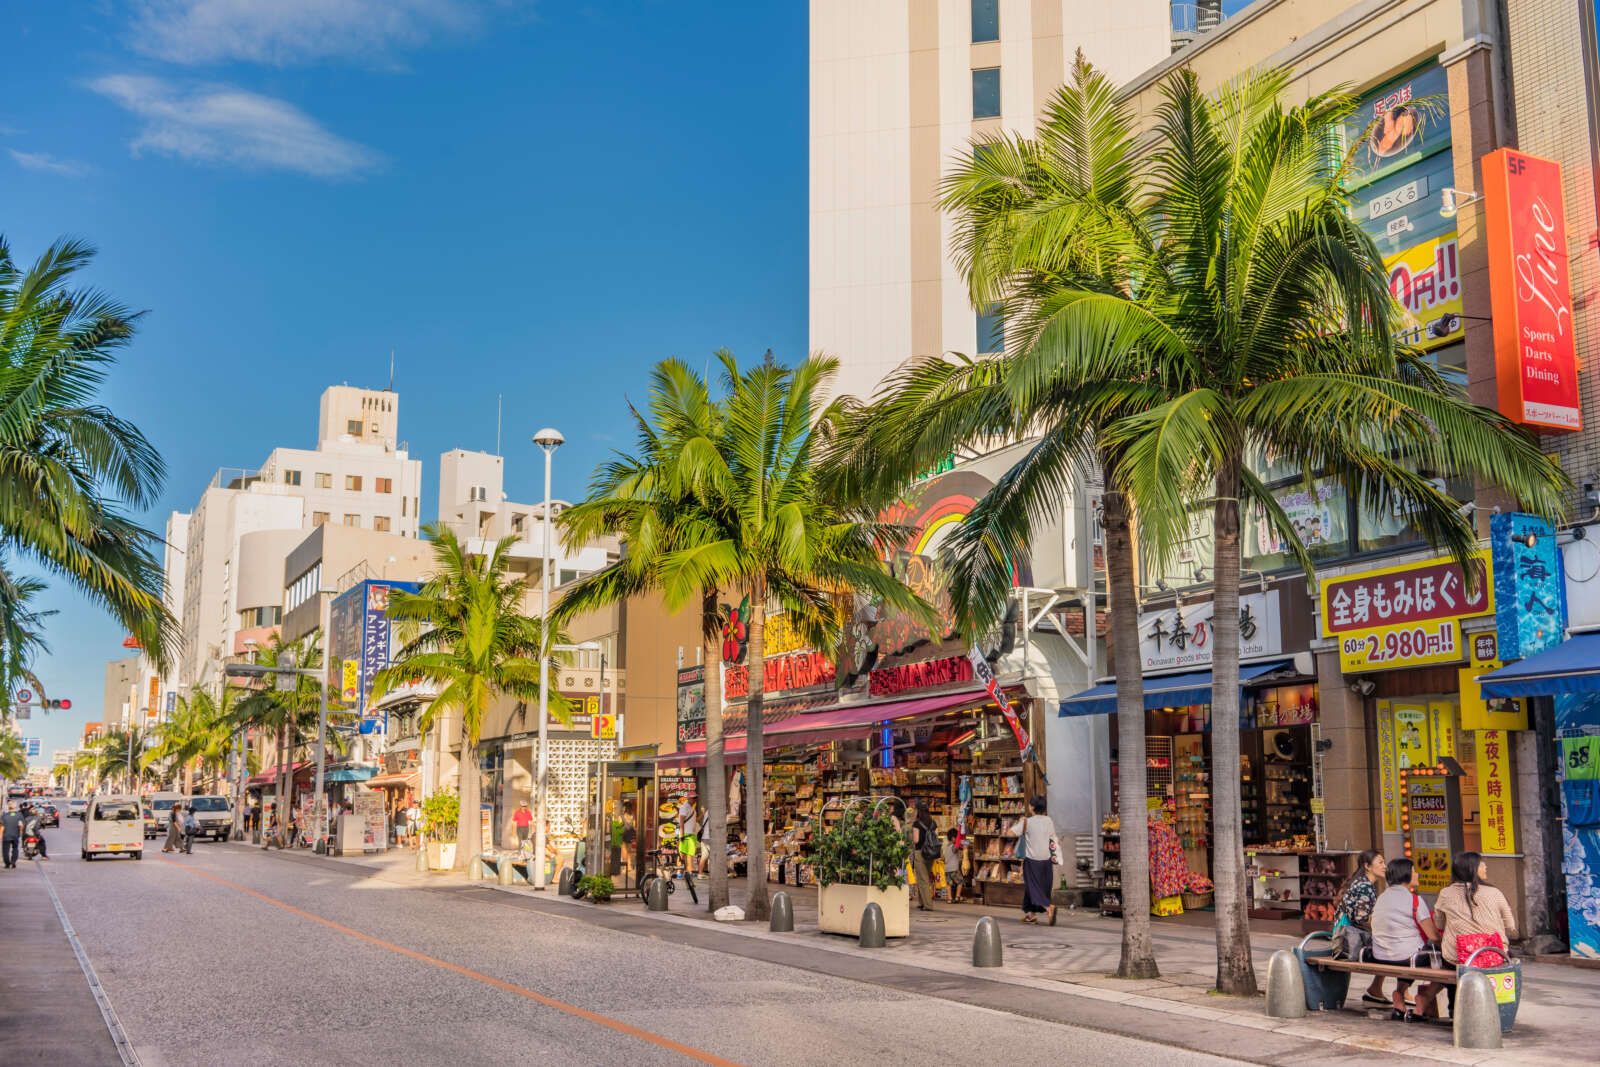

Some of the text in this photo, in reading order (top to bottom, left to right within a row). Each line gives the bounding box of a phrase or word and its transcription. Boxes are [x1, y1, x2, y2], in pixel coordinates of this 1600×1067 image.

[1373, 187, 1416, 215] りらくる
[1517, 196, 1569, 336] Line
[1523, 325, 1556, 344] Sports
[1525, 346, 1553, 362] Darts
[1526, 365, 1560, 385] Dining
[366, 614, 377, 676] アニメグッズ
[377, 620, 387, 670] フィギュア
